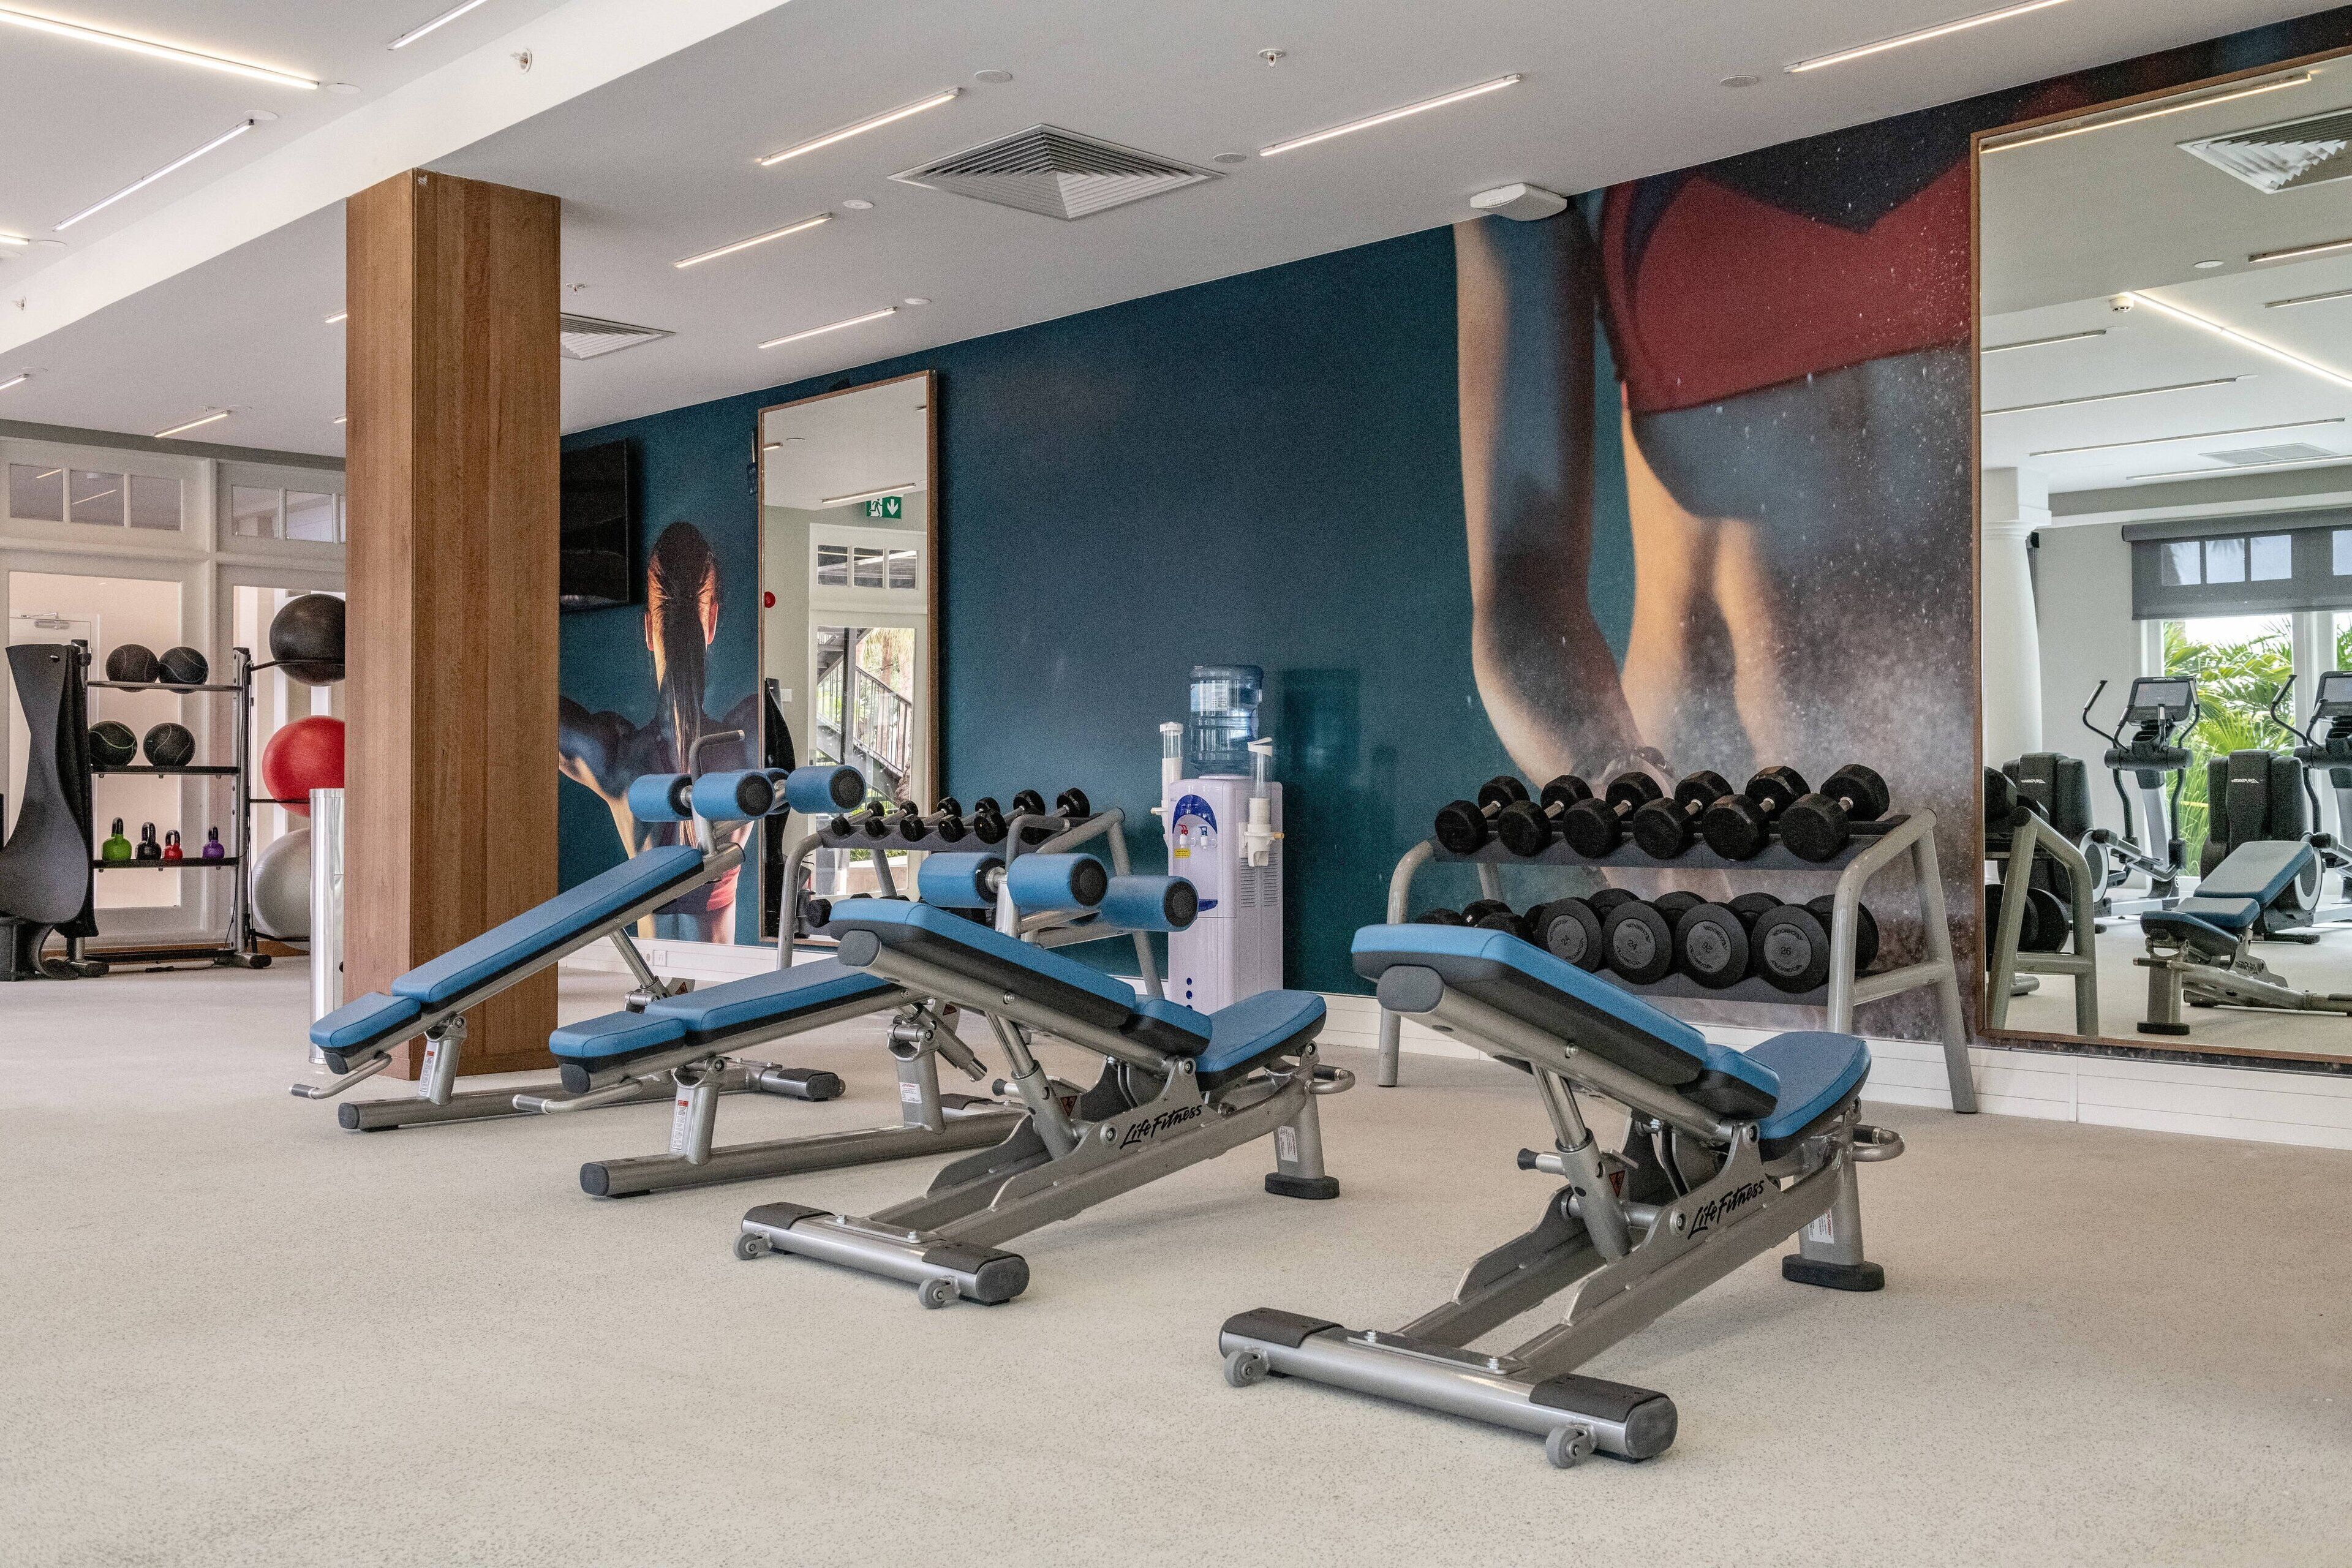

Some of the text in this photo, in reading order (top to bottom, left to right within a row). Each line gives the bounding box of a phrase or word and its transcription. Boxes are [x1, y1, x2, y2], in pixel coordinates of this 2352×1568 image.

[1561, 935, 1570, 946] 24
[1627, 939, 1638, 950] 24
[1701, 941, 1713, 954] 26
[1780, 946, 1792, 956] 26
[1119, 1104, 1202, 1150] Life Fitness
[1687, 1180, 1765, 1240] Life Fitness
